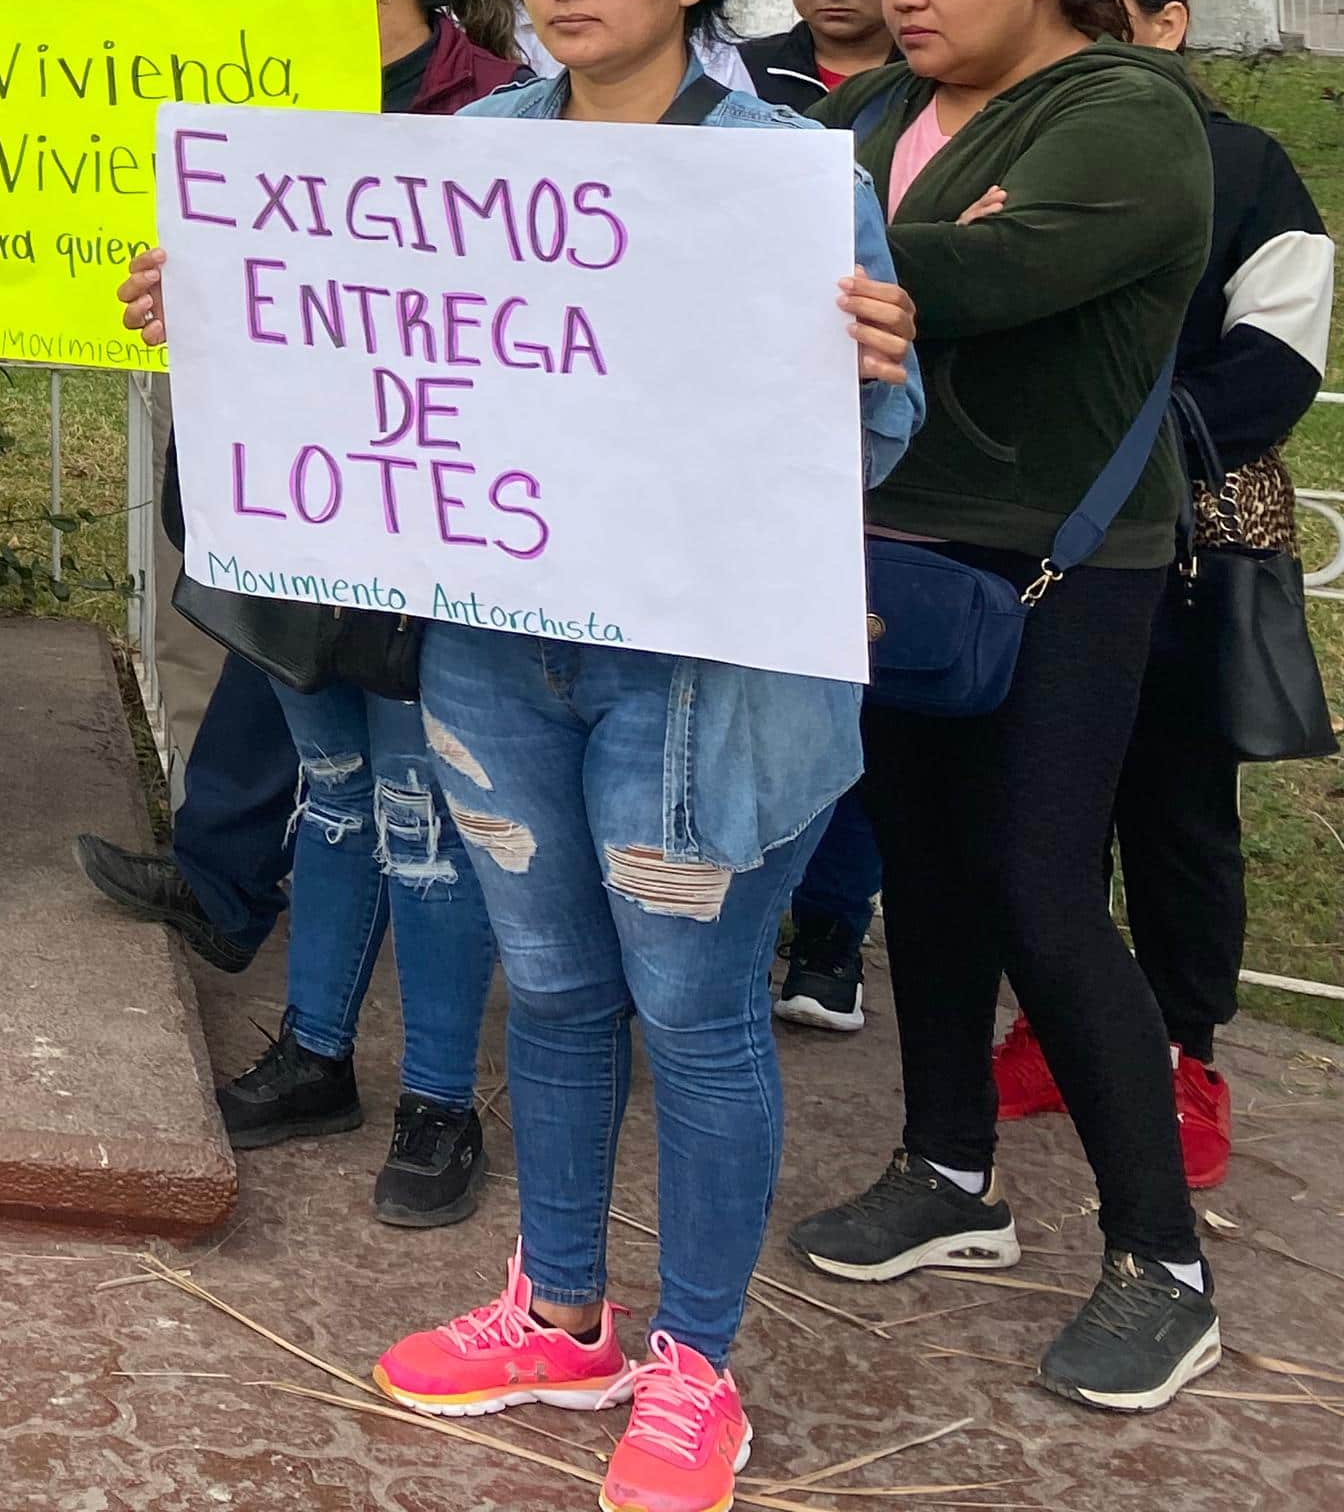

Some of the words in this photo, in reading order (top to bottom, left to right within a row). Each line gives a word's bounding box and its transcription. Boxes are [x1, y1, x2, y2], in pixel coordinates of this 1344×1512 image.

[172, 129, 629, 270] EXIGIMOS
[243, 257, 607, 377] ENTREGA
[368, 367, 474, 451] DE
[232, 441, 550, 559] LOTES
[208, 551, 406, 611] Movimiento
